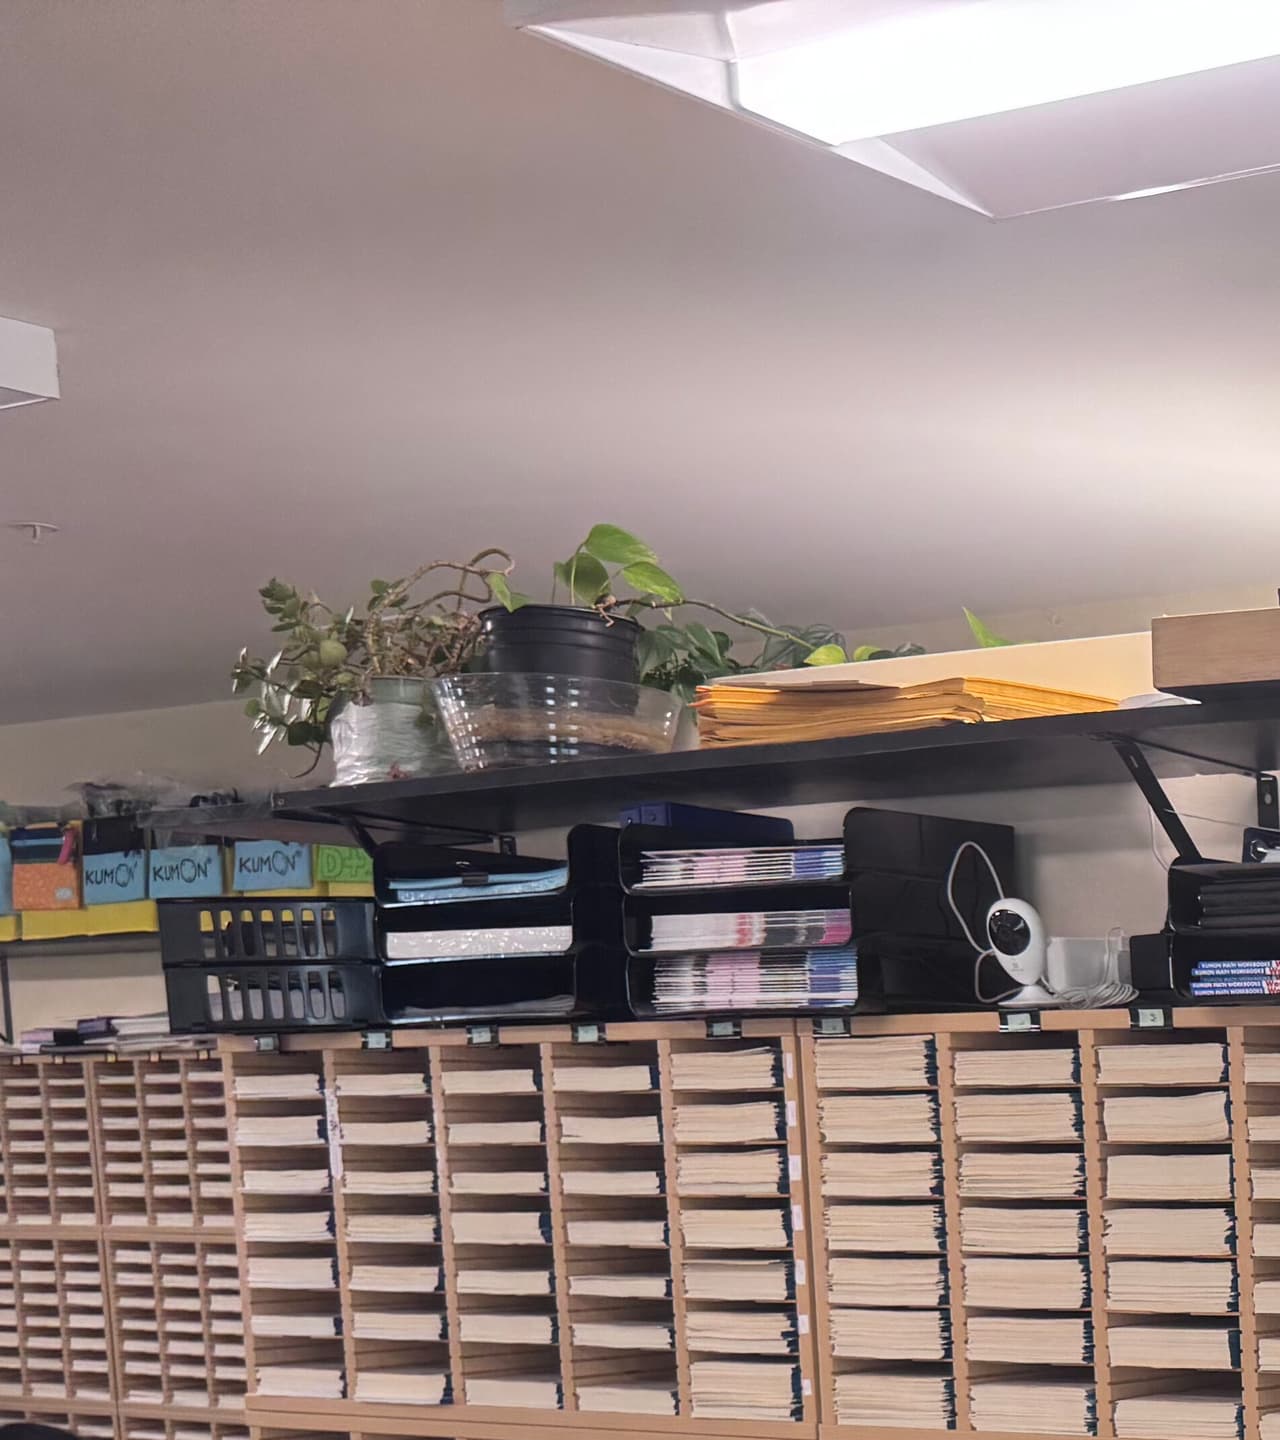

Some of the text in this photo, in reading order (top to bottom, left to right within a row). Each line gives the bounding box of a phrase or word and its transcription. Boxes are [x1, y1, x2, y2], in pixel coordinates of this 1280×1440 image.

[85, 863, 138, 887] KUMON
[153, 858, 213, 884] KUMON
[239, 850, 300, 876] KUMON
